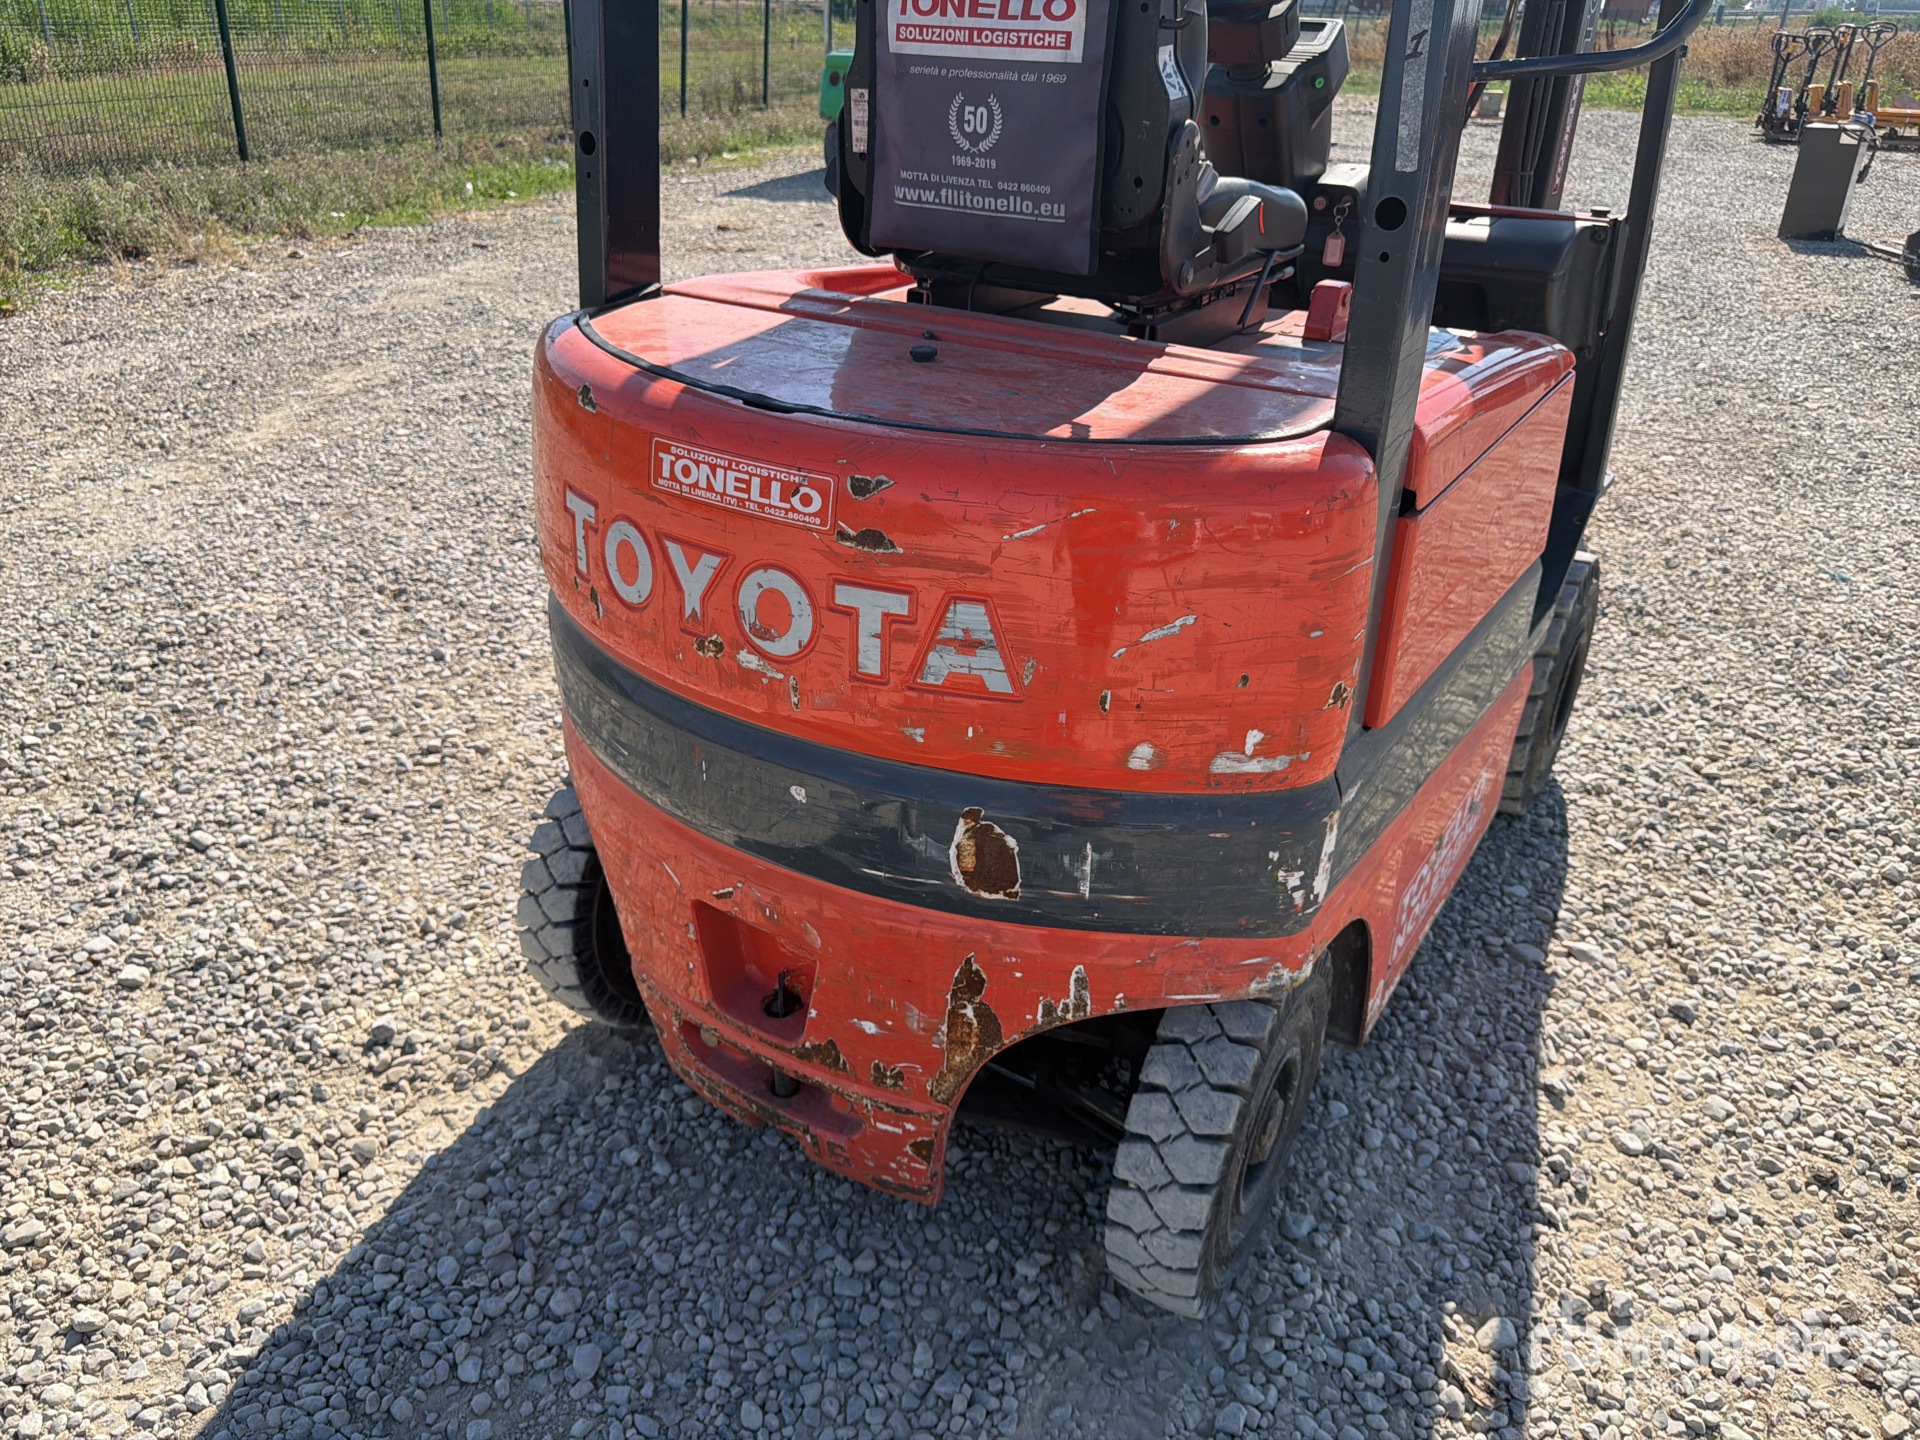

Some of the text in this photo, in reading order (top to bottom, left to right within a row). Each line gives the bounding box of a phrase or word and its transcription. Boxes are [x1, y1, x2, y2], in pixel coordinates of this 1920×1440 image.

[899, 26, 1067, 47] SOLUZIONI LOGISTICHE
[909, 64, 1067, 84] serietà e professionalità dal 1969
[963, 105, 988, 134] 50
[951, 154, 997, 170] 1969-2019
[900, 169, 1051, 195] MOTTA DI LIVENZA TEL 0422 860409
[894, 185, 1066, 217] www.fllitonello.eu
[670, 446, 809, 485] SOLUZIONI LOGISTICHE
[658, 451, 823, 514] TONELLO
[657, 477, 681, 491] MOTTA
[681, 484, 690, 493] DI
[690, 486, 722, 502] LIVENZA
[722, 495, 738, 507] (TV)
[744, 501, 763, 512] TEL.
[764, 506, 821, 525] 0422.860409
[563, 486, 1020, 698] TOYOTA
